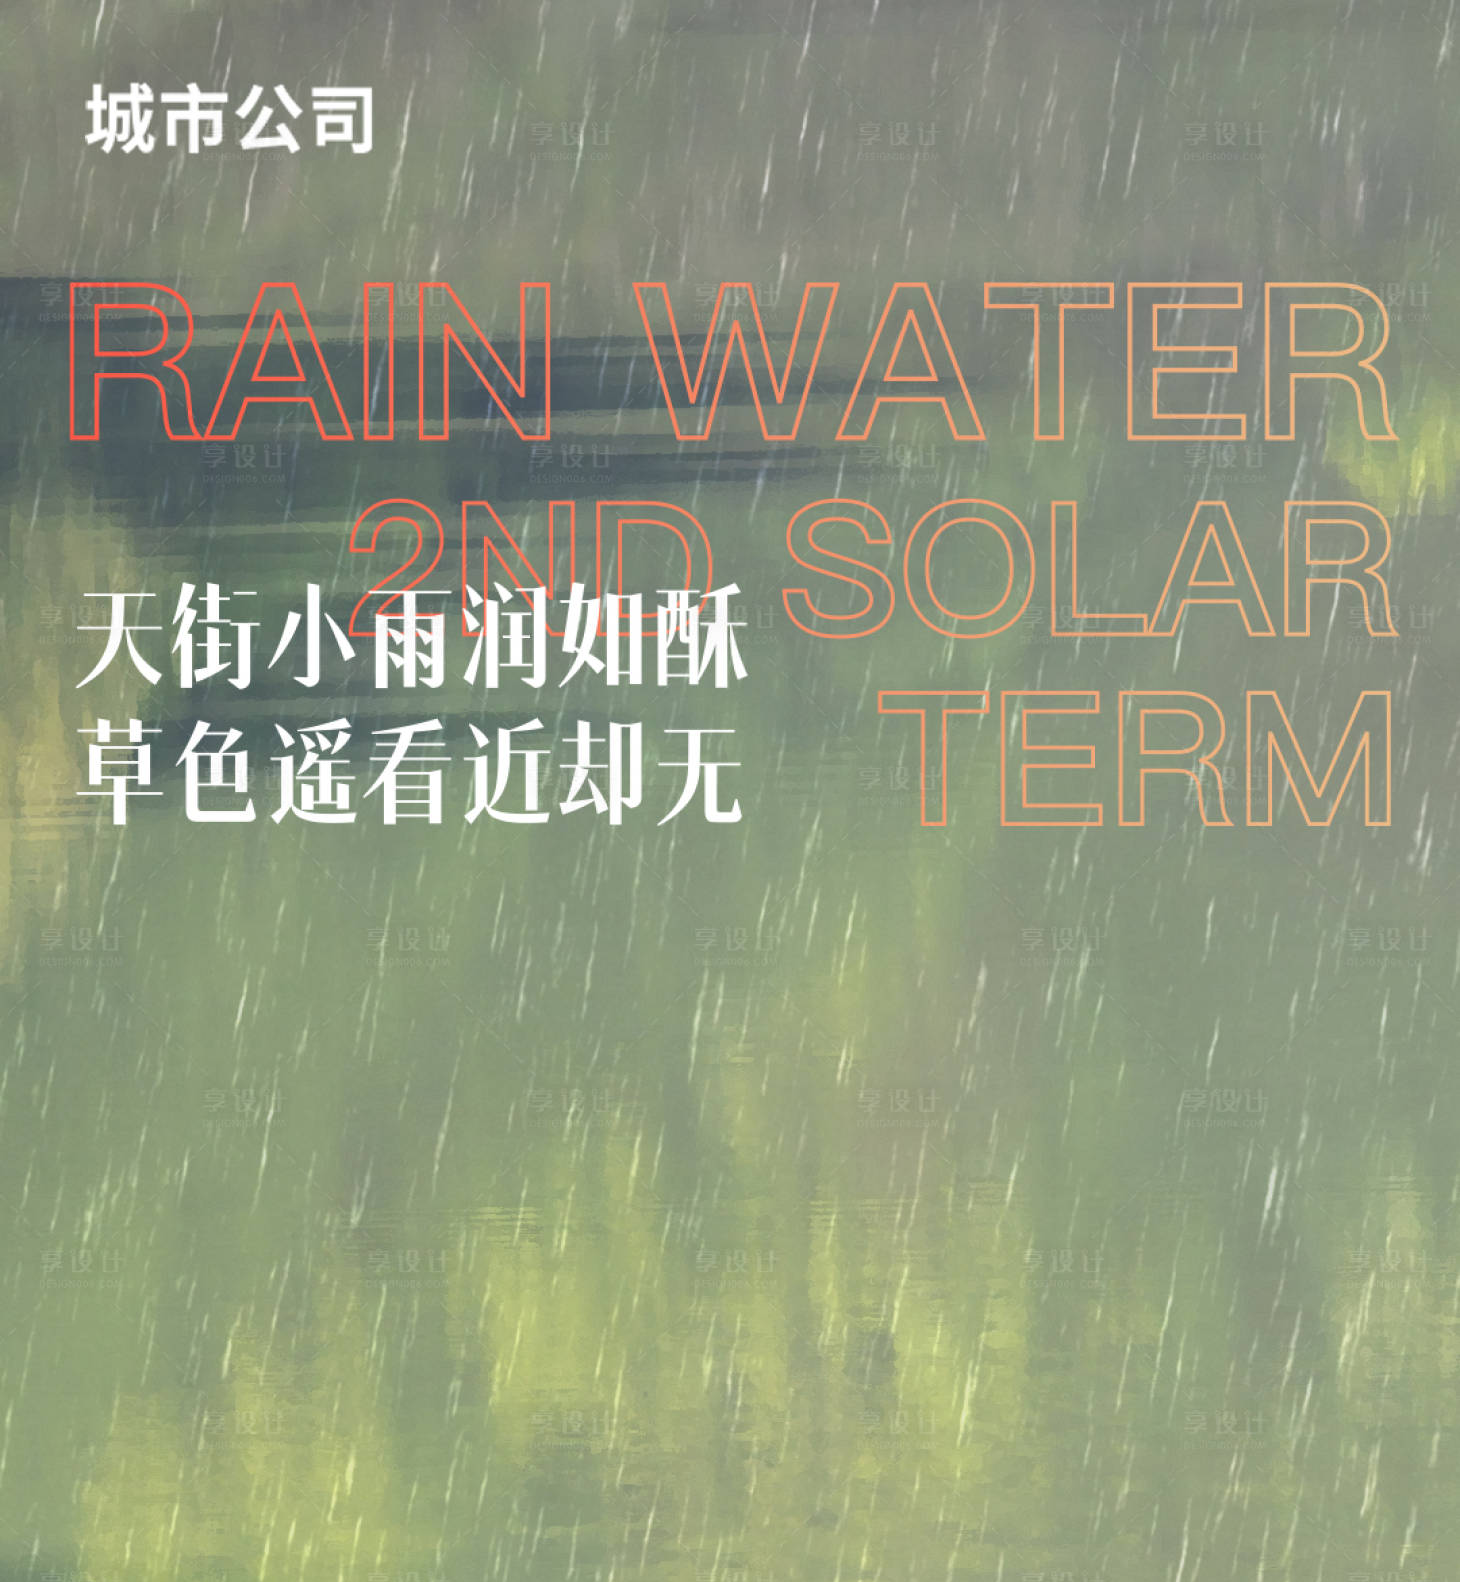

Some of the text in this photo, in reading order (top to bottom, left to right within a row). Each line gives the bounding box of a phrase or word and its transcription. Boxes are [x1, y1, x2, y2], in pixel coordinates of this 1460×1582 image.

[85, 82, 373, 154] 城市公司
[70, 281, 1399, 441] RAIN WATER
[349, 497, 1399, 640] 2ND SOLAR
[76, 582, 748, 690] 天街小雨润如酥
[76, 718, 743, 826] 草色遥看近却无
[878, 690, 1391, 827] TERM
